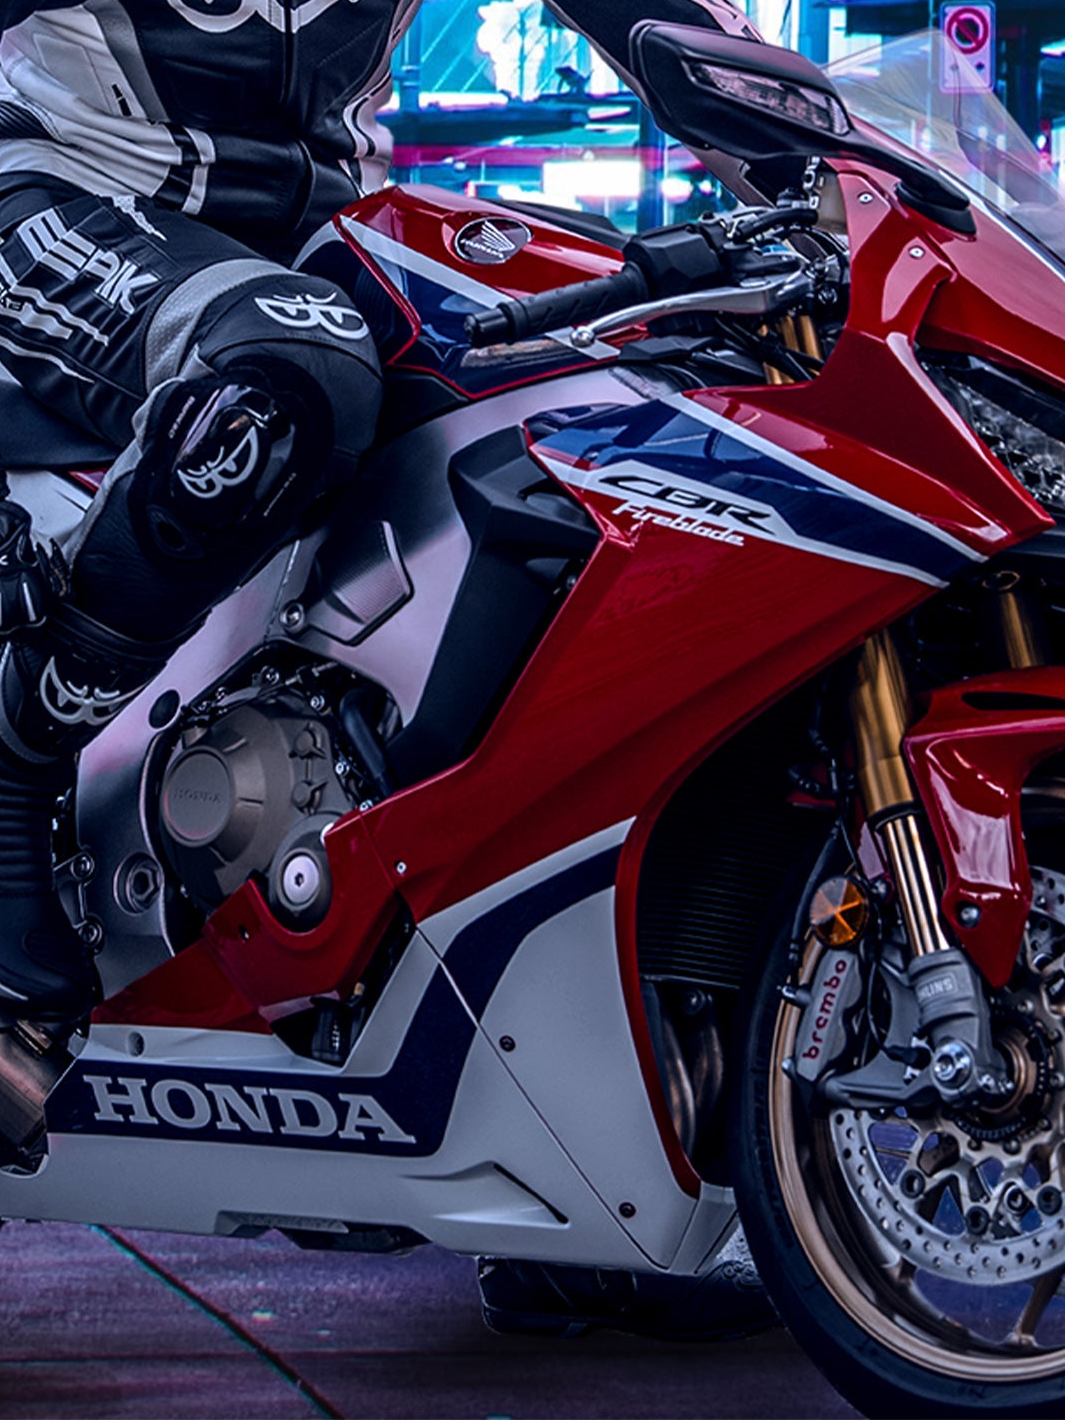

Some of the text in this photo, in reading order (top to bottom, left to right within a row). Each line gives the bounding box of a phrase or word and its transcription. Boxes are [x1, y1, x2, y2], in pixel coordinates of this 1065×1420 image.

[599, 476, 776, 536] CBR
[612, 500, 745, 547] Fireblade
[802, 959, 848, 1059] brembo
[83, 1074, 417, 1144] HONDA
